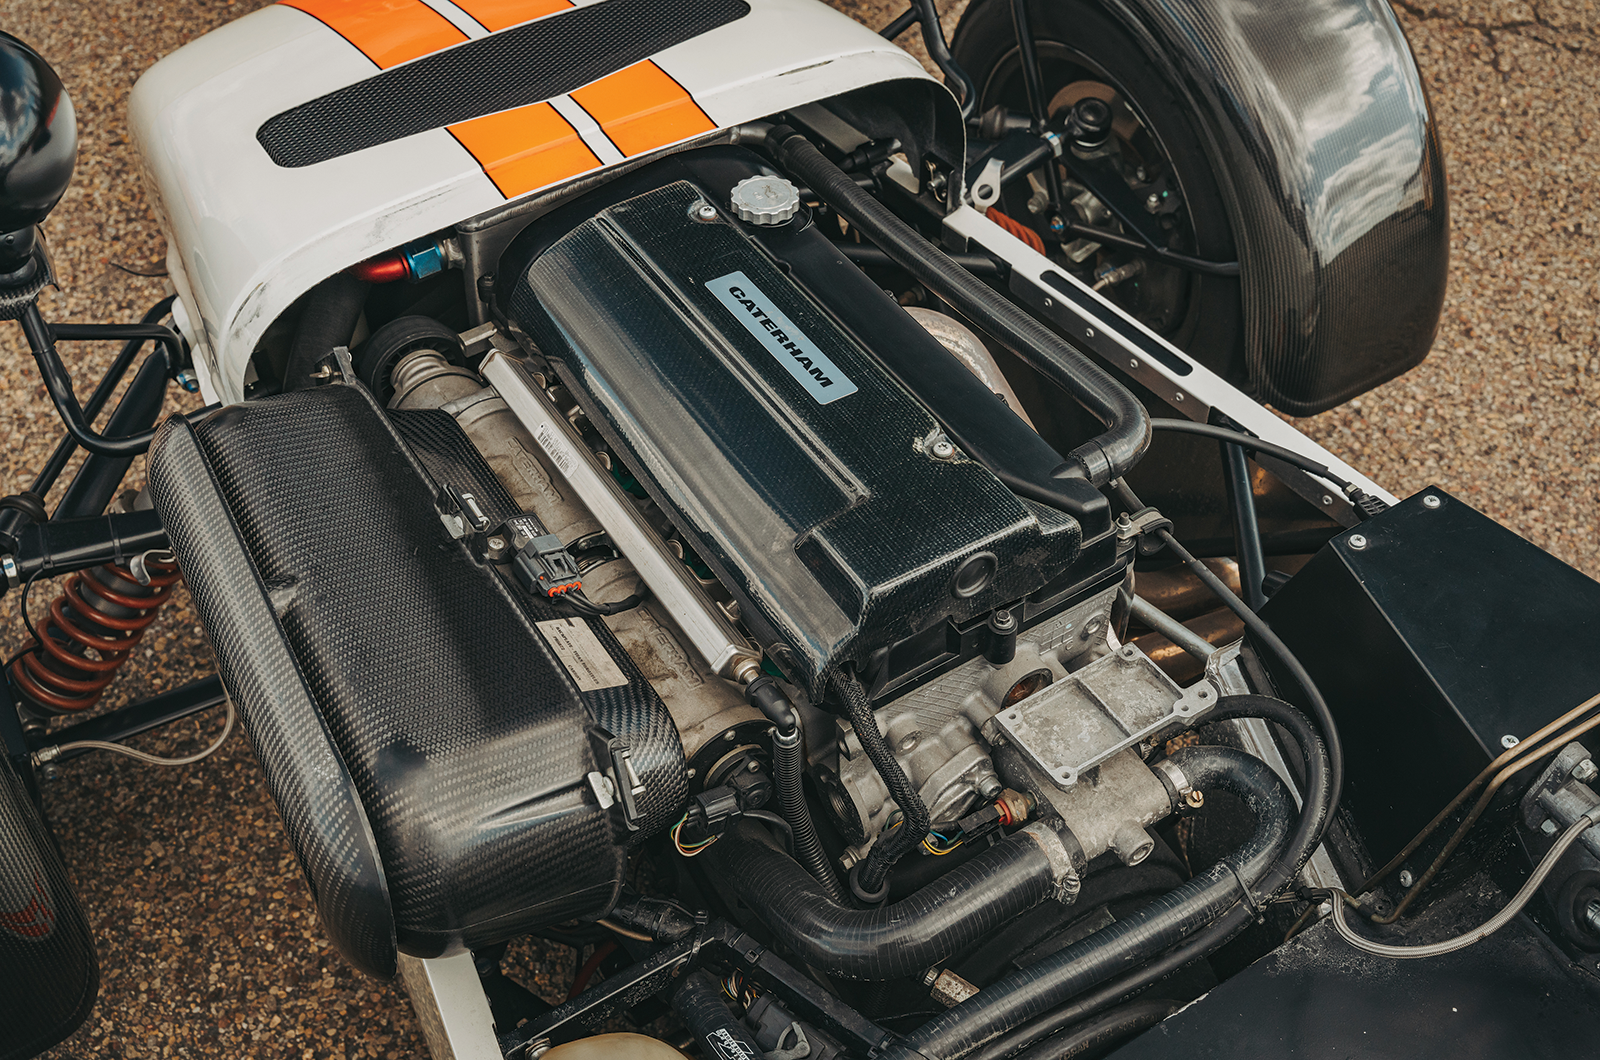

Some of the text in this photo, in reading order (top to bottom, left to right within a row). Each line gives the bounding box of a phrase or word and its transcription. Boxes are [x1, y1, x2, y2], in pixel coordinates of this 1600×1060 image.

[729, 286, 834, 388] CATERHAM
[637, 607, 702, 688] CATERHAM
[1315, 734, 1329, 762] HOSE
